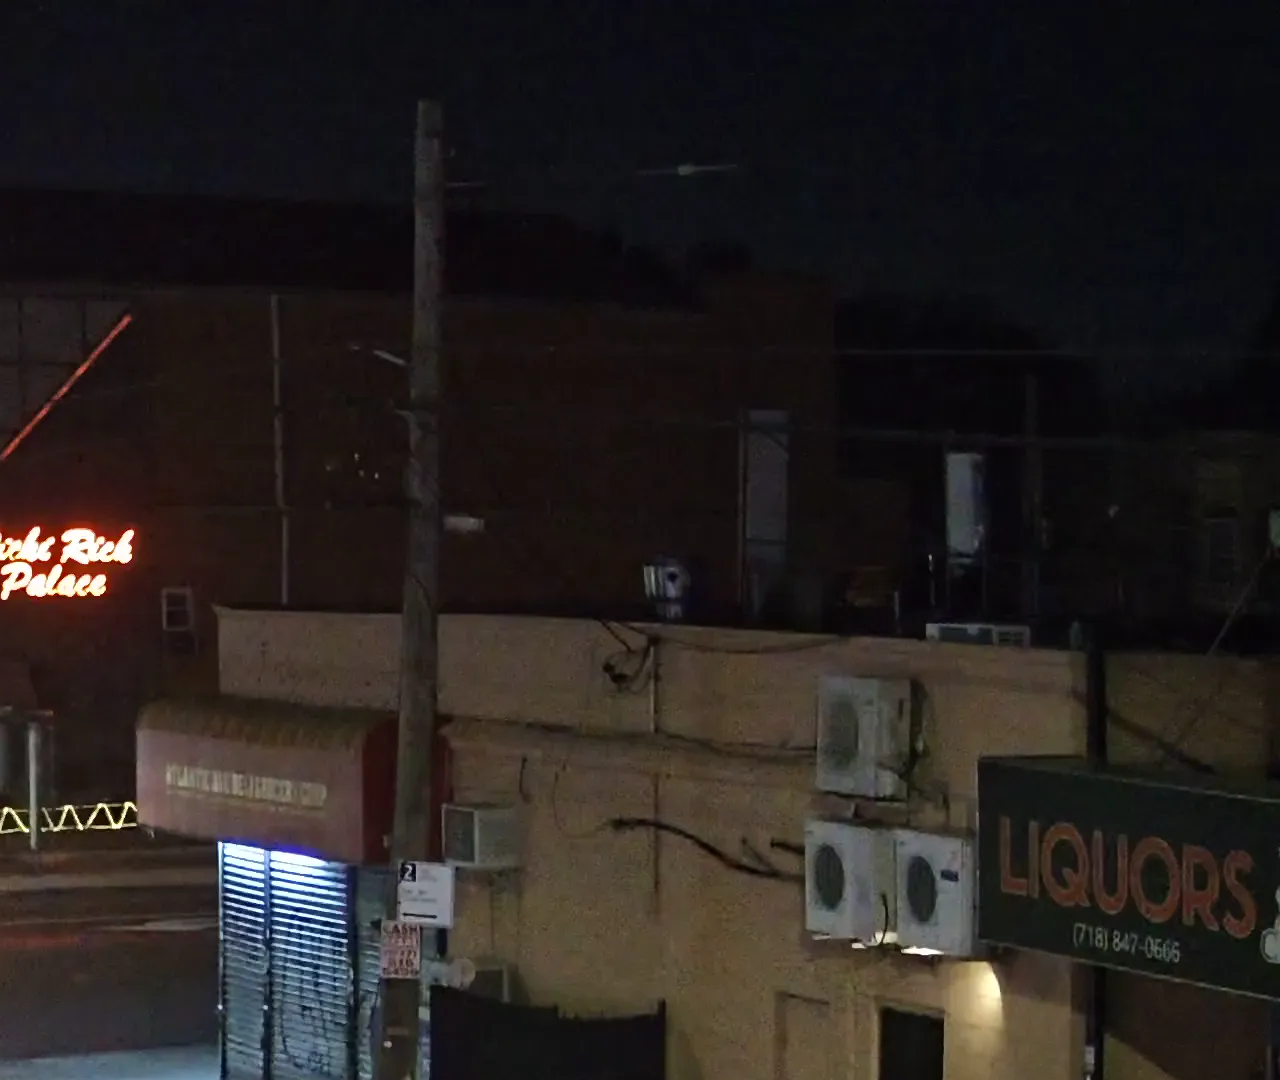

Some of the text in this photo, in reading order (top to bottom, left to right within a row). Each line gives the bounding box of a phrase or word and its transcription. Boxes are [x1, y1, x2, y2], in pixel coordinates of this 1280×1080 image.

[60, 527, 134, 564] Rich
[0, 561, 106, 600] Palace
[403, 864, 413, 881] 2
[999, 815, 1257, 939] LIQUORS
[1073, 922, 1109, 952] (718)
